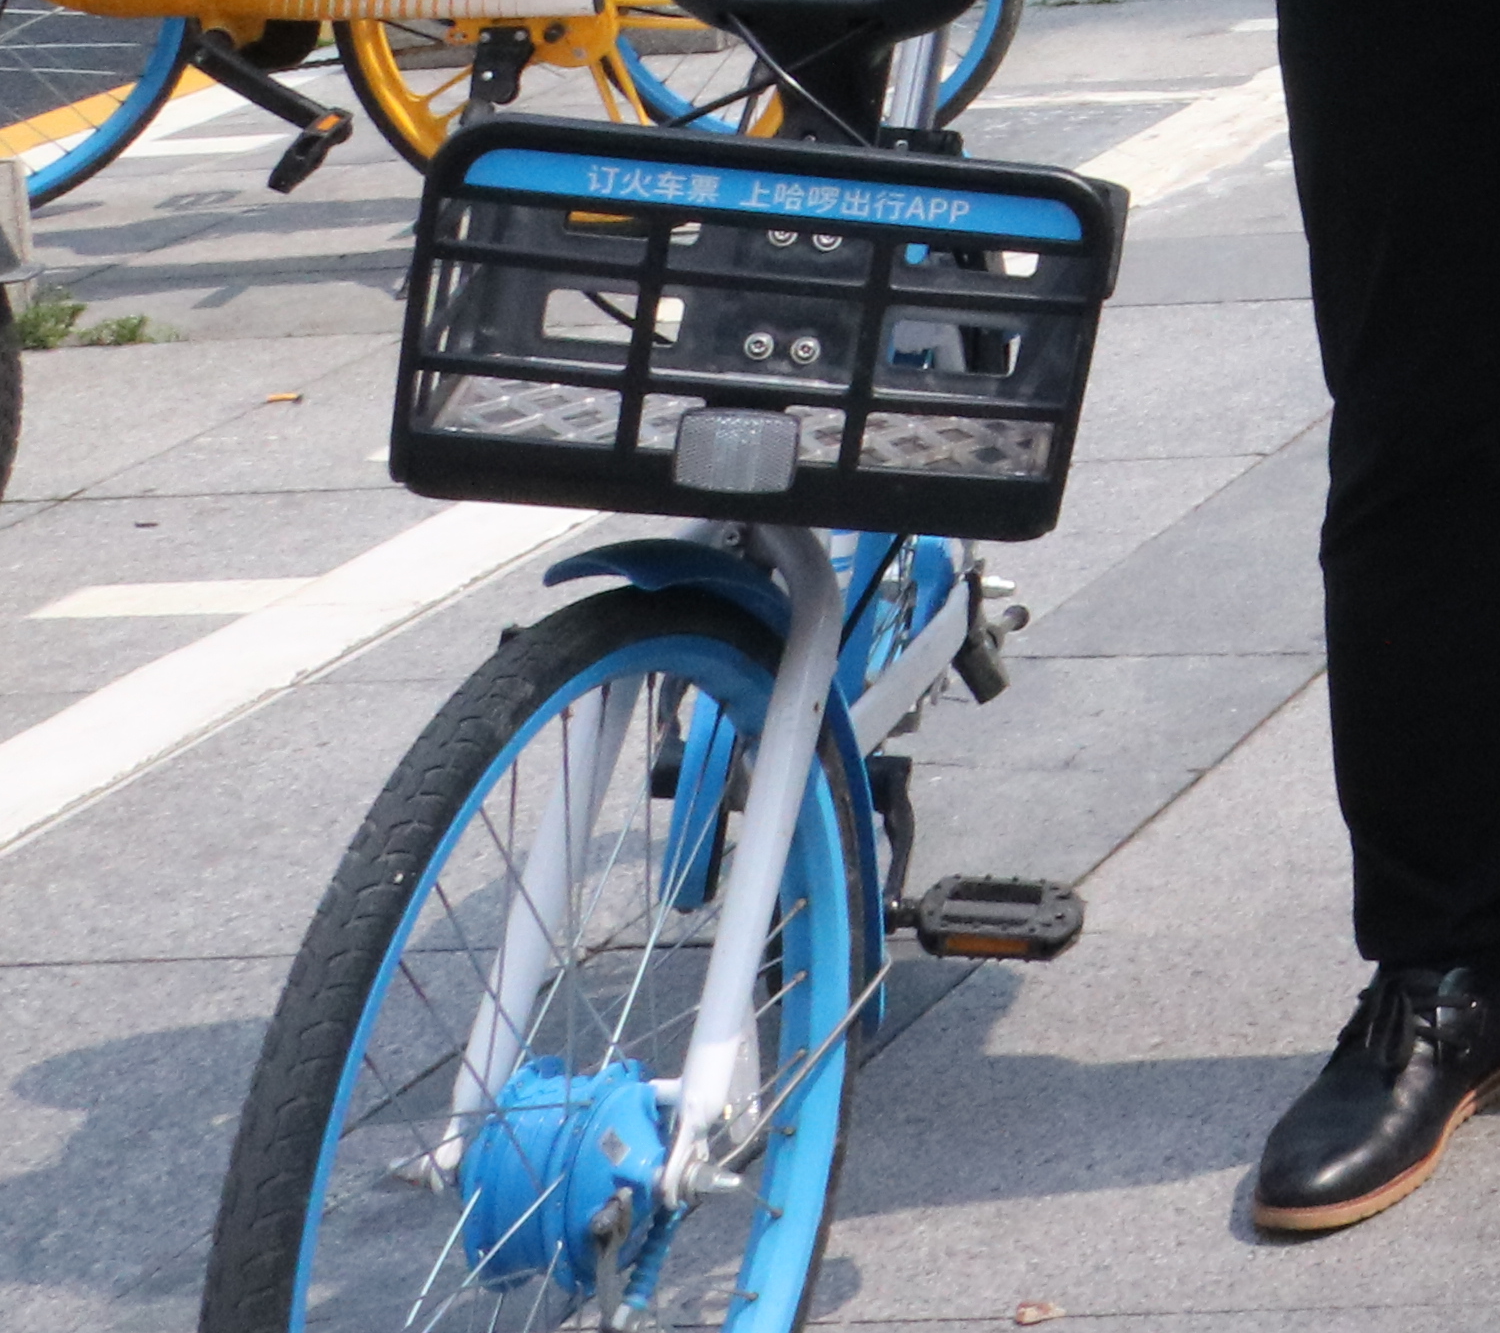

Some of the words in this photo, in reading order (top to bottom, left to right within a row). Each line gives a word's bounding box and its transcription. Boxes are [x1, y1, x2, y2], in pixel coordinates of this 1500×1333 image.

[588, 164, 720, 205] 订火车票
[740, 180, 971, 223] 上哈啰出行APP
